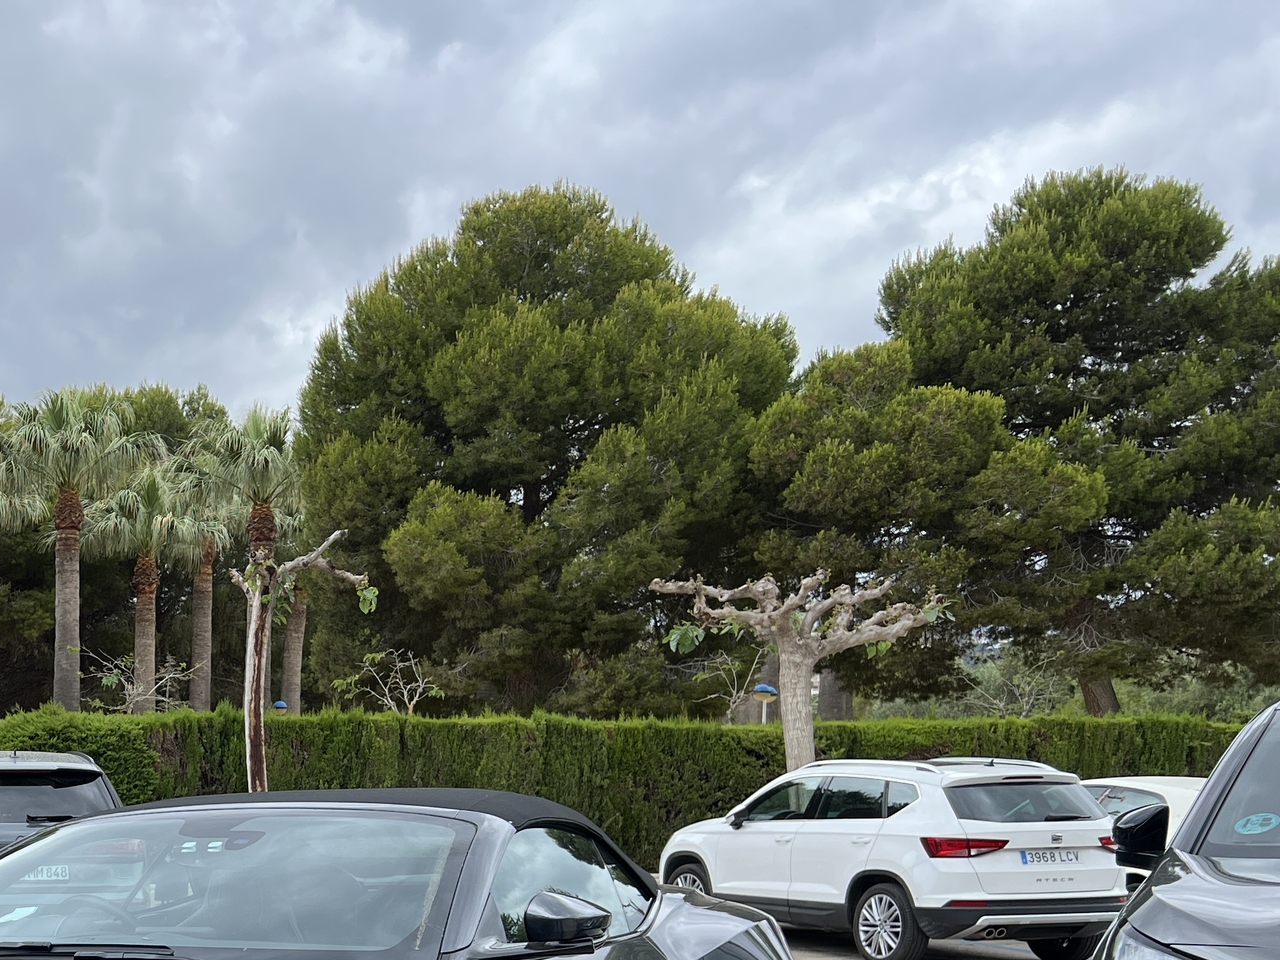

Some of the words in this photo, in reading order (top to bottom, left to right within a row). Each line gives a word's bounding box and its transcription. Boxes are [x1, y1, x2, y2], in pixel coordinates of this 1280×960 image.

[1027, 851, 1057, 863] 3968
[1058, 850, 1079, 862] LCV
[46, 866, 68, 878] 848
